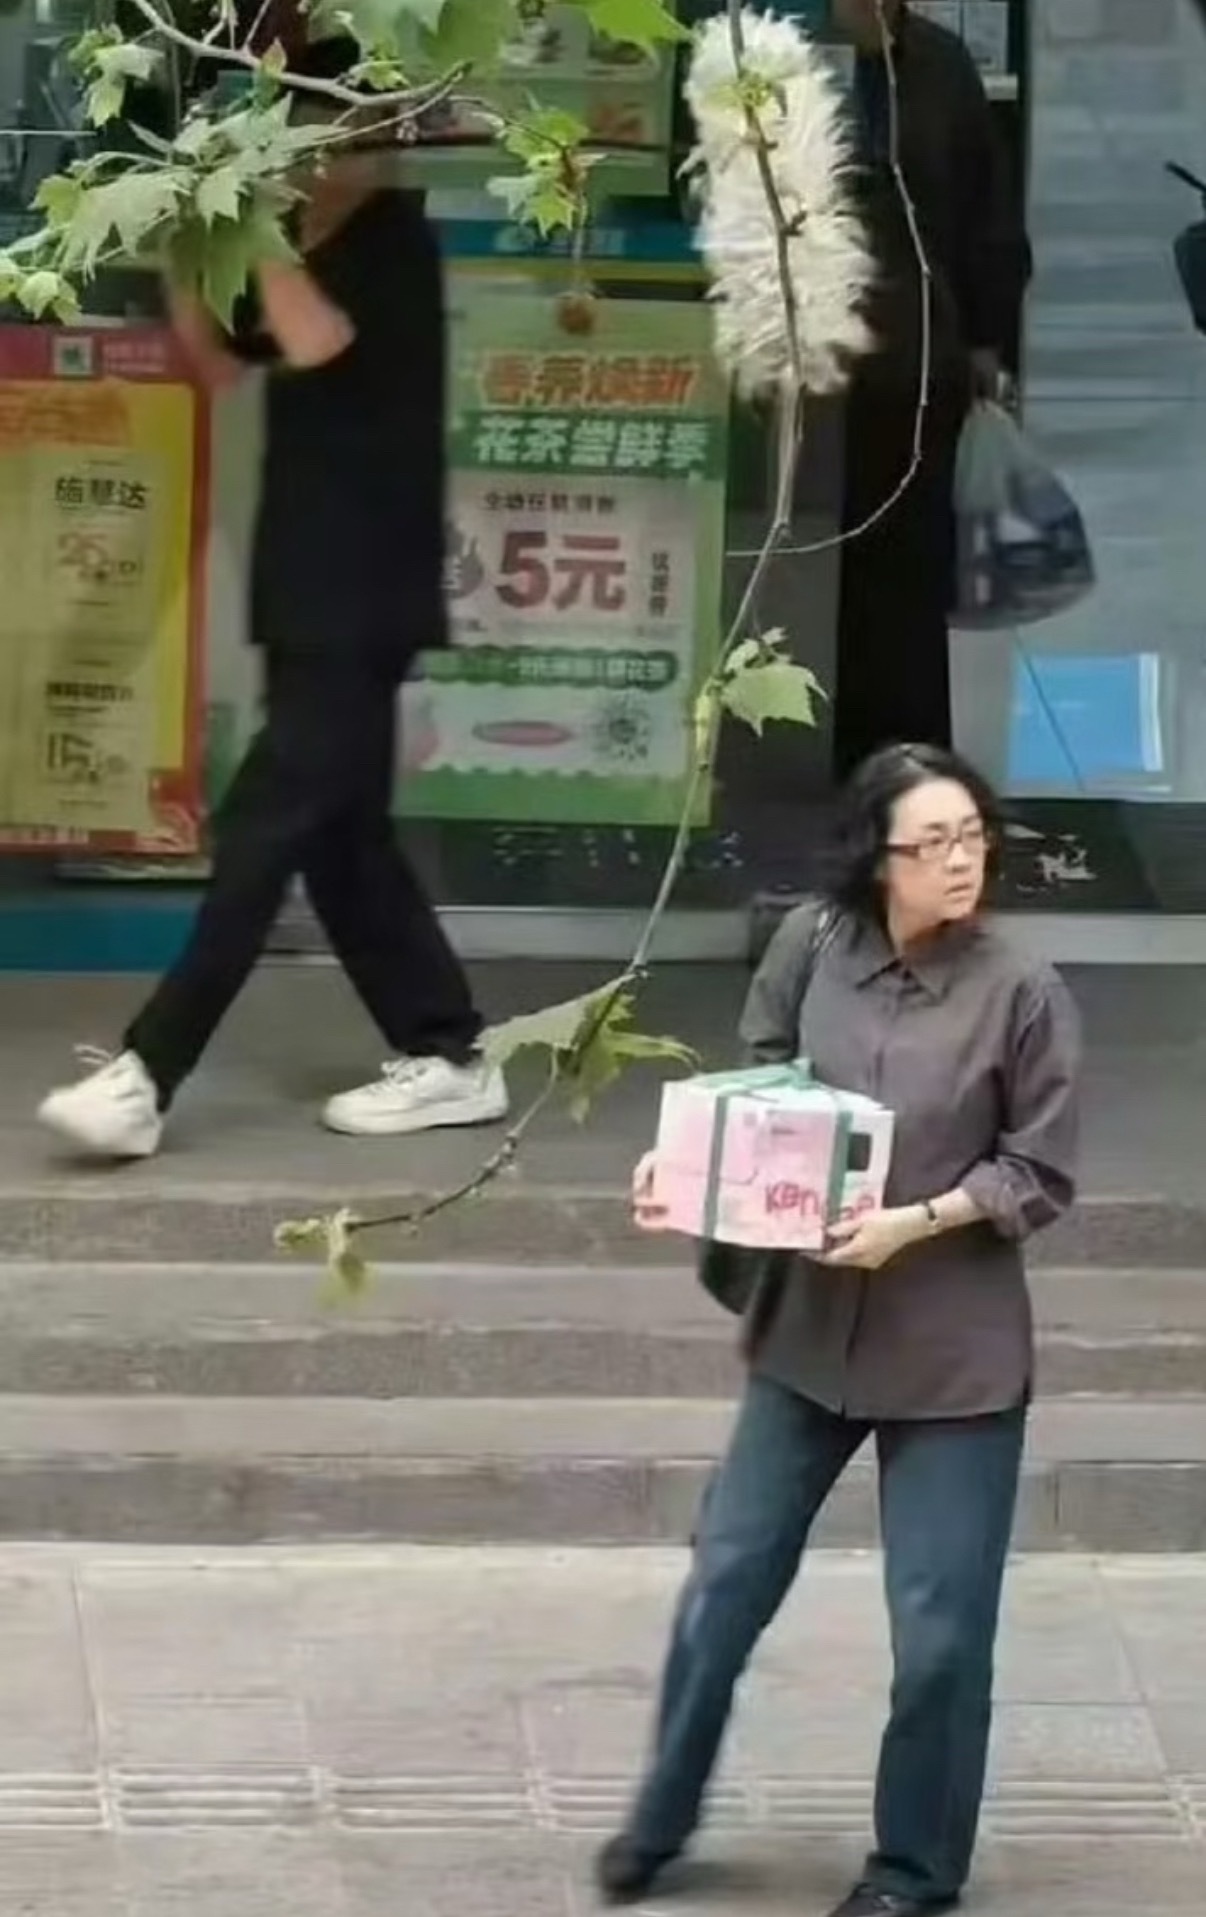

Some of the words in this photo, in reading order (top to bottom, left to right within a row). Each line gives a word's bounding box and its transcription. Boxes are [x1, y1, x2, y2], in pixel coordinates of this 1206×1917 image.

[475, 417, 710, 470] 花茶尝鲜季
[495, 530, 627, 611] 5元
